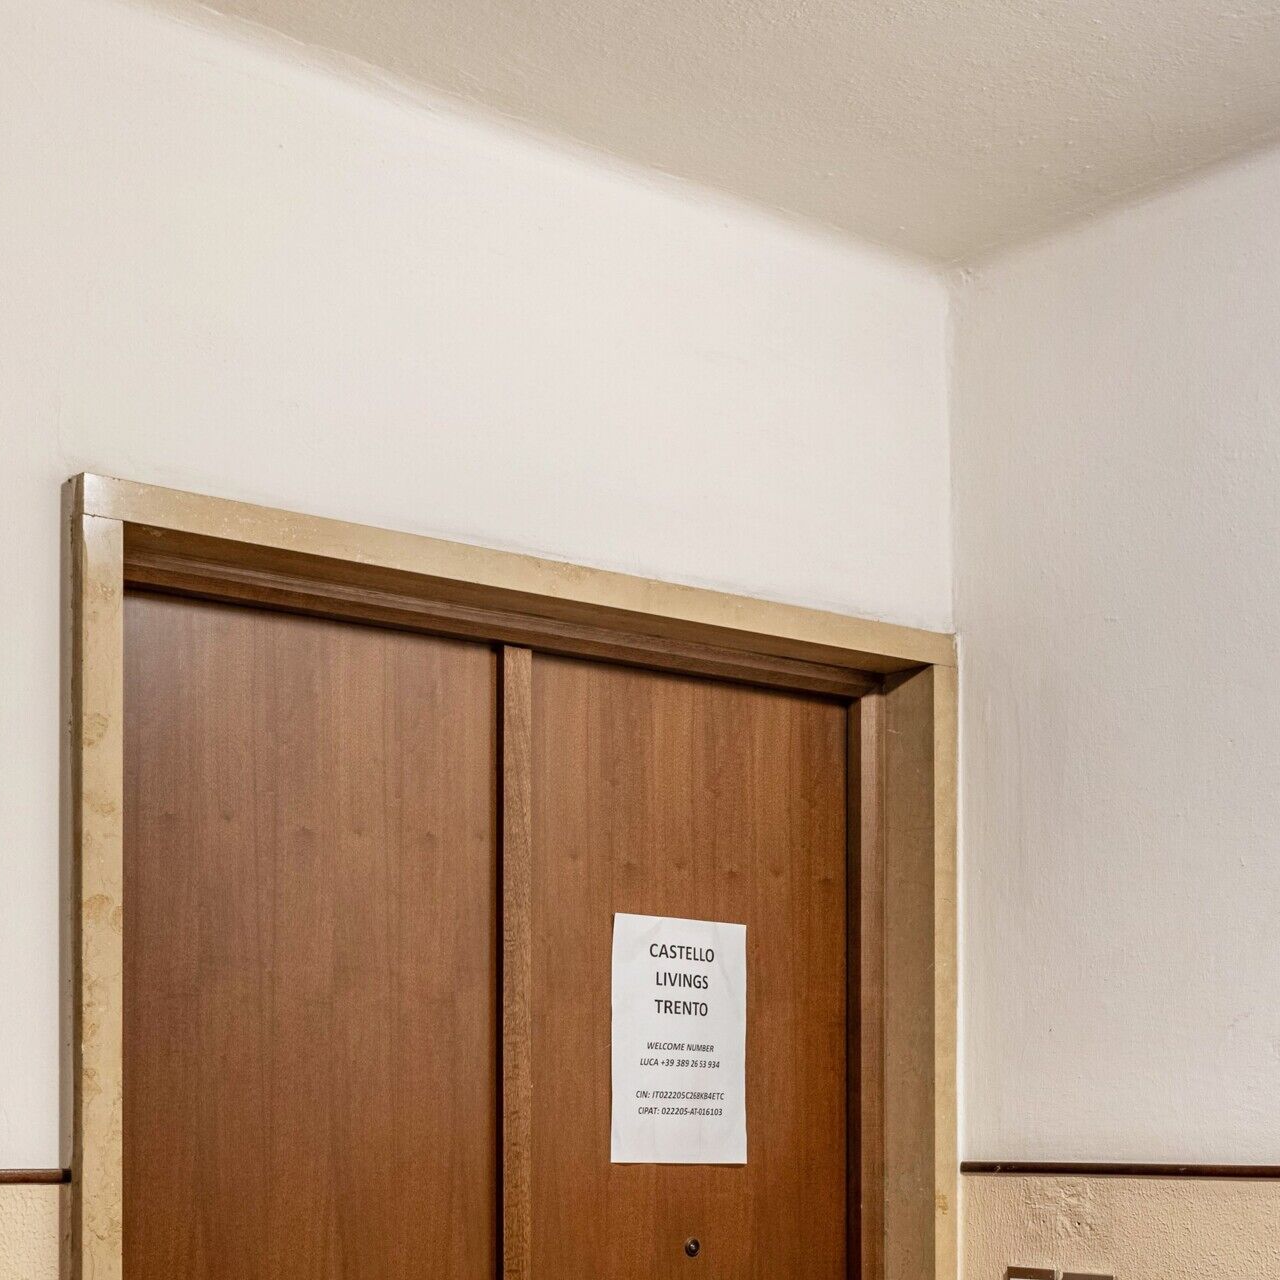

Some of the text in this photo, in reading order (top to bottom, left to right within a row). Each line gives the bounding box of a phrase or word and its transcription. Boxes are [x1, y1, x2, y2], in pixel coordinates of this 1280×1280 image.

[649, 943, 715, 963] CASTELLO
[655, 971, 709, 990] LIVINGS
[654, 999, 709, 1017] TRENTO
[647, 1041, 714, 1053] WELCOME NUMBER
[640, 1058, 659, 1067] LUCA
[661, 1058, 675, 1067] +39
[676, 1059, 690, 1068] 389
[707, 1060, 720, 1069] 934
[635, 1090, 651, 1099] CIN:
[638, 1106, 660, 1115] CIPAT:
